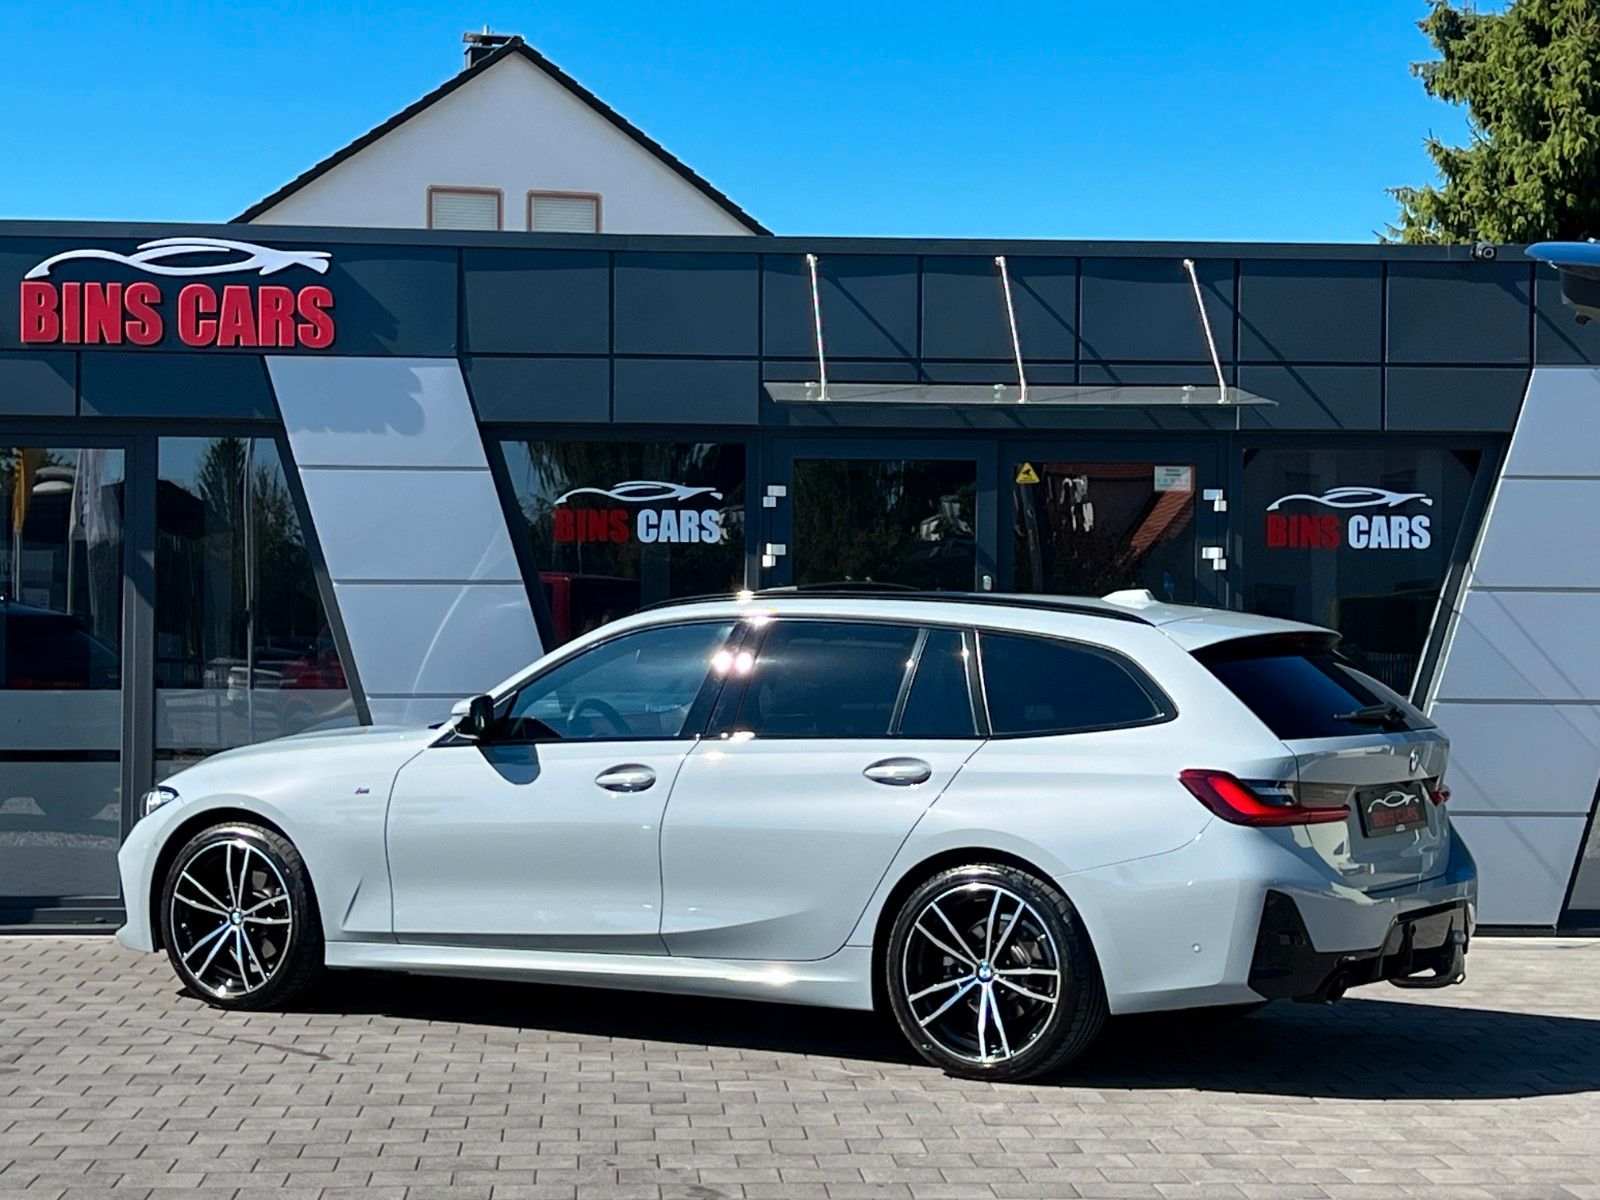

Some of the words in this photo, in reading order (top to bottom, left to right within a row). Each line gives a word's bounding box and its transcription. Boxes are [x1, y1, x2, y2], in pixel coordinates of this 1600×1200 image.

[20, 281, 163, 346] BINS
[177, 283, 335, 348] CARS
[555, 509, 630, 543] BINS
[637, 509, 722, 544] CARS
[1266, 514, 1340, 548] BINS
[1348, 514, 1432, 549] CARS
